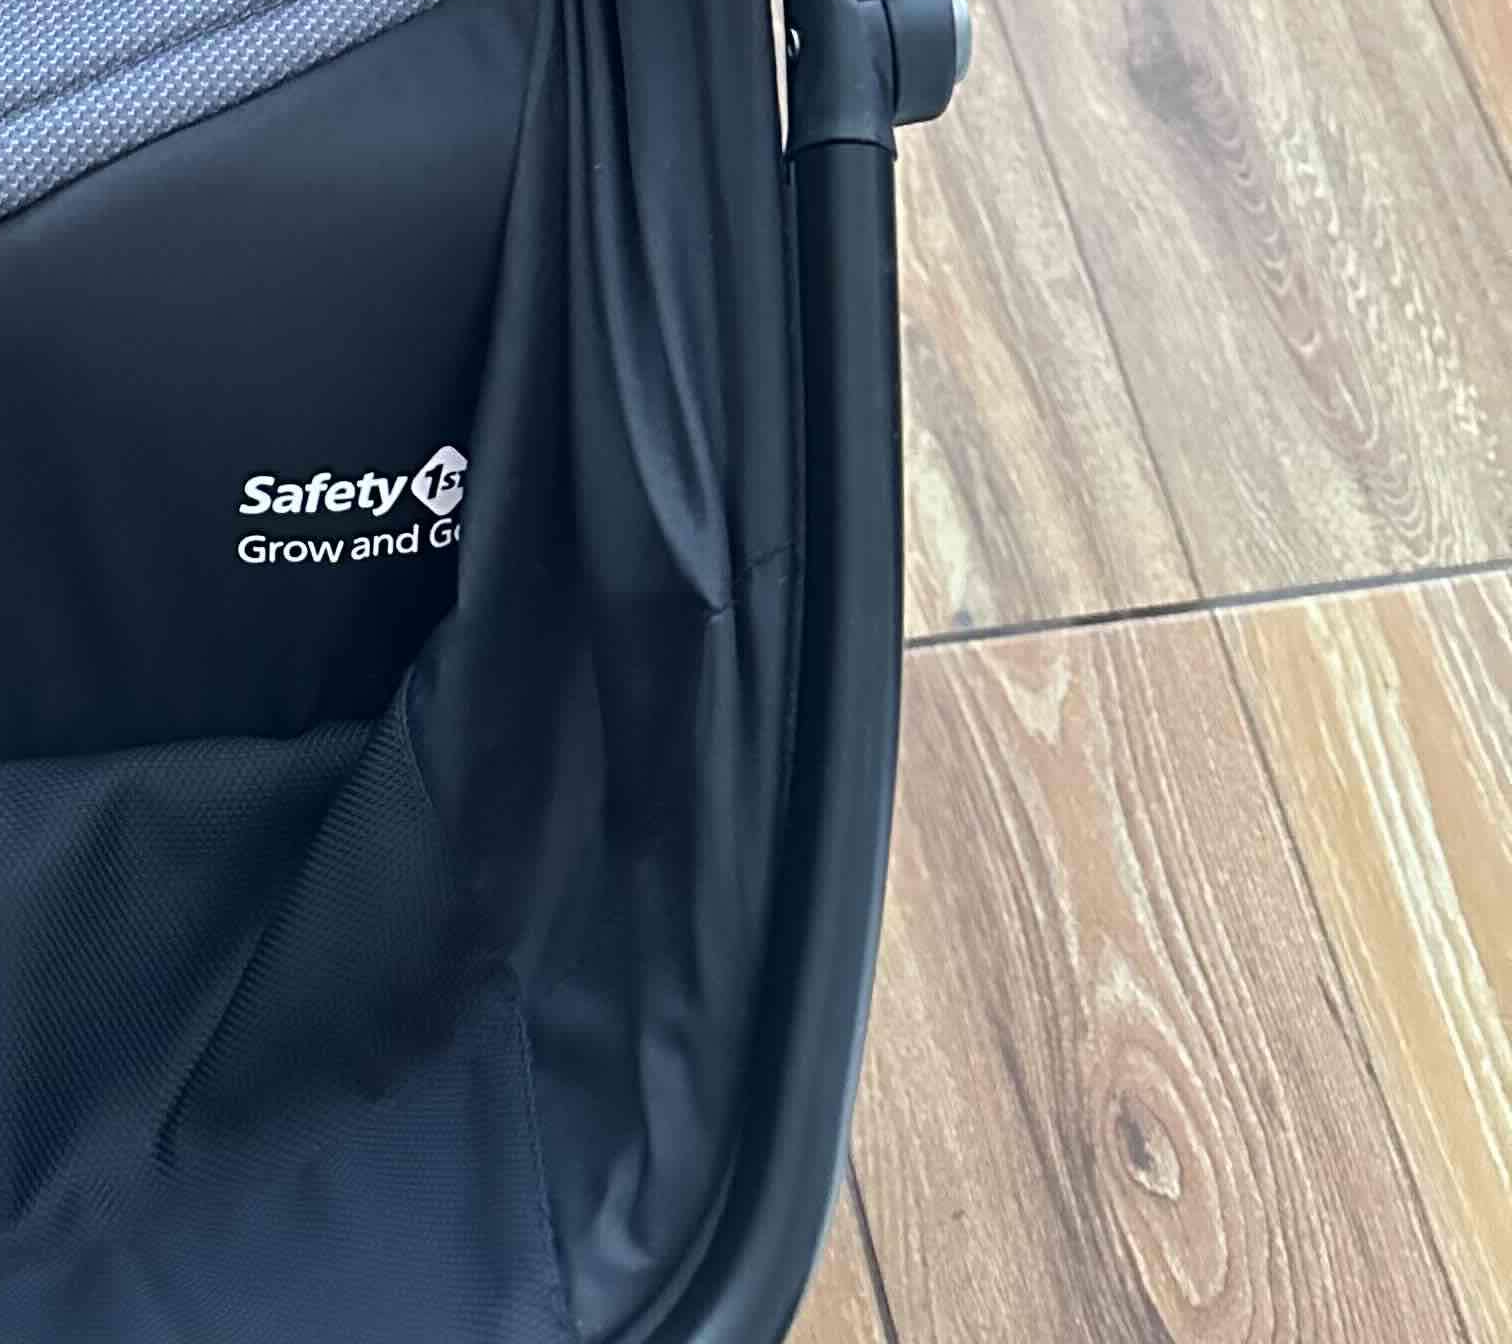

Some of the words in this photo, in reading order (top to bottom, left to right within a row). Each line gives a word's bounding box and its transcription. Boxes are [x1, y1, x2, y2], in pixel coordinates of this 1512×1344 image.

[239, 471, 408, 517] Safety
[238, 535, 344, 564] Grow
[351, 524, 419, 560] and
